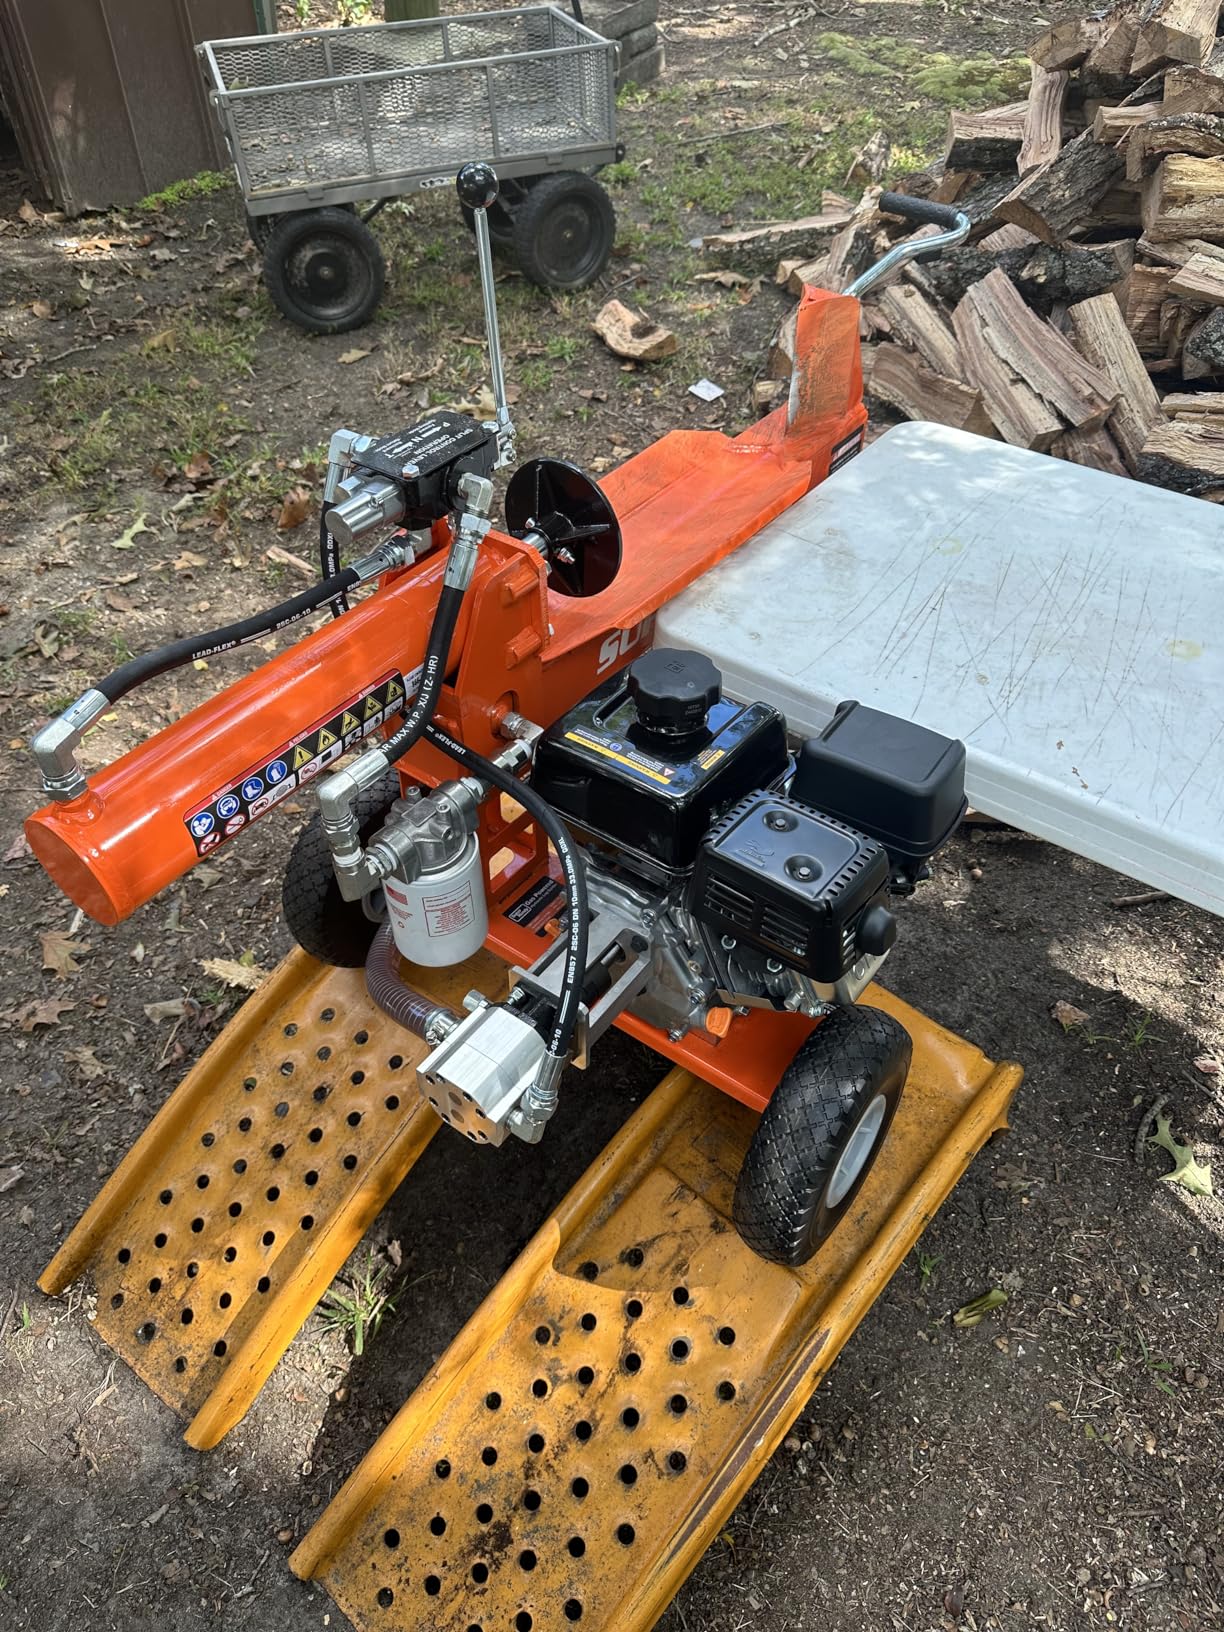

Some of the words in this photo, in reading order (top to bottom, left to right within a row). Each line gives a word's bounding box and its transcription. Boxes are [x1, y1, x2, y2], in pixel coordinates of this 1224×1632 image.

[413, 434, 450, 455] OPERATION
[426, 437, 457, 455] CONTROL
[389, 727, 410, 745] MAX
[565, 854, 576, 885] 33.0MPa
[524, 896, 536, 906] Gas
[571, 885, 579, 907] 10mm
[572, 908, 579, 921] DN
[570, 922, 579, 951] 2SC-06
[567, 955, 577, 984] EN857
